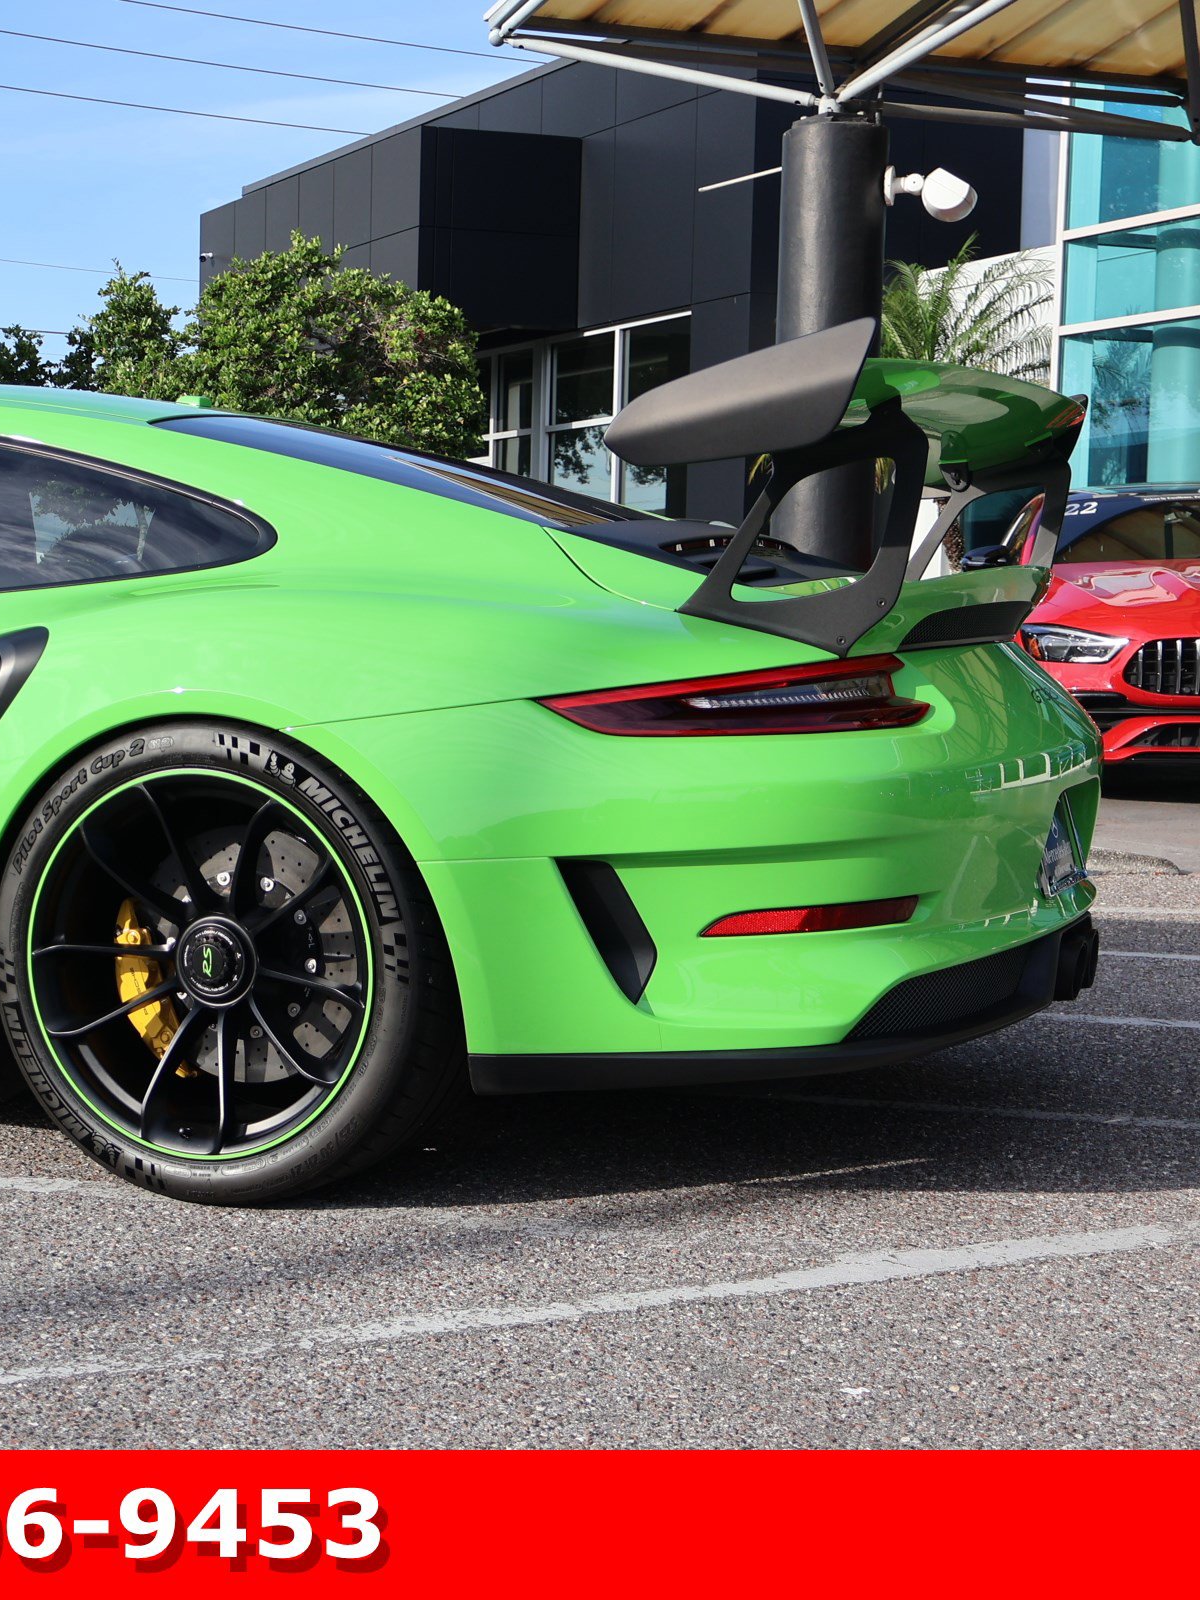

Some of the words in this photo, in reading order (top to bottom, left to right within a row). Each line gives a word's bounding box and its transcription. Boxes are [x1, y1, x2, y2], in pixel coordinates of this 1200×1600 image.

[12, 817, 44, 875] Pilot
[41, 767, 88, 825] Sport
[90, 749, 126, 775] Cup
[129, 738, 146, 757] 2
[299, 776, 400, 919] MICHELIN
[202, 946, 212, 978] RS
[3, 1004, 91, 1142] MICHELIN
